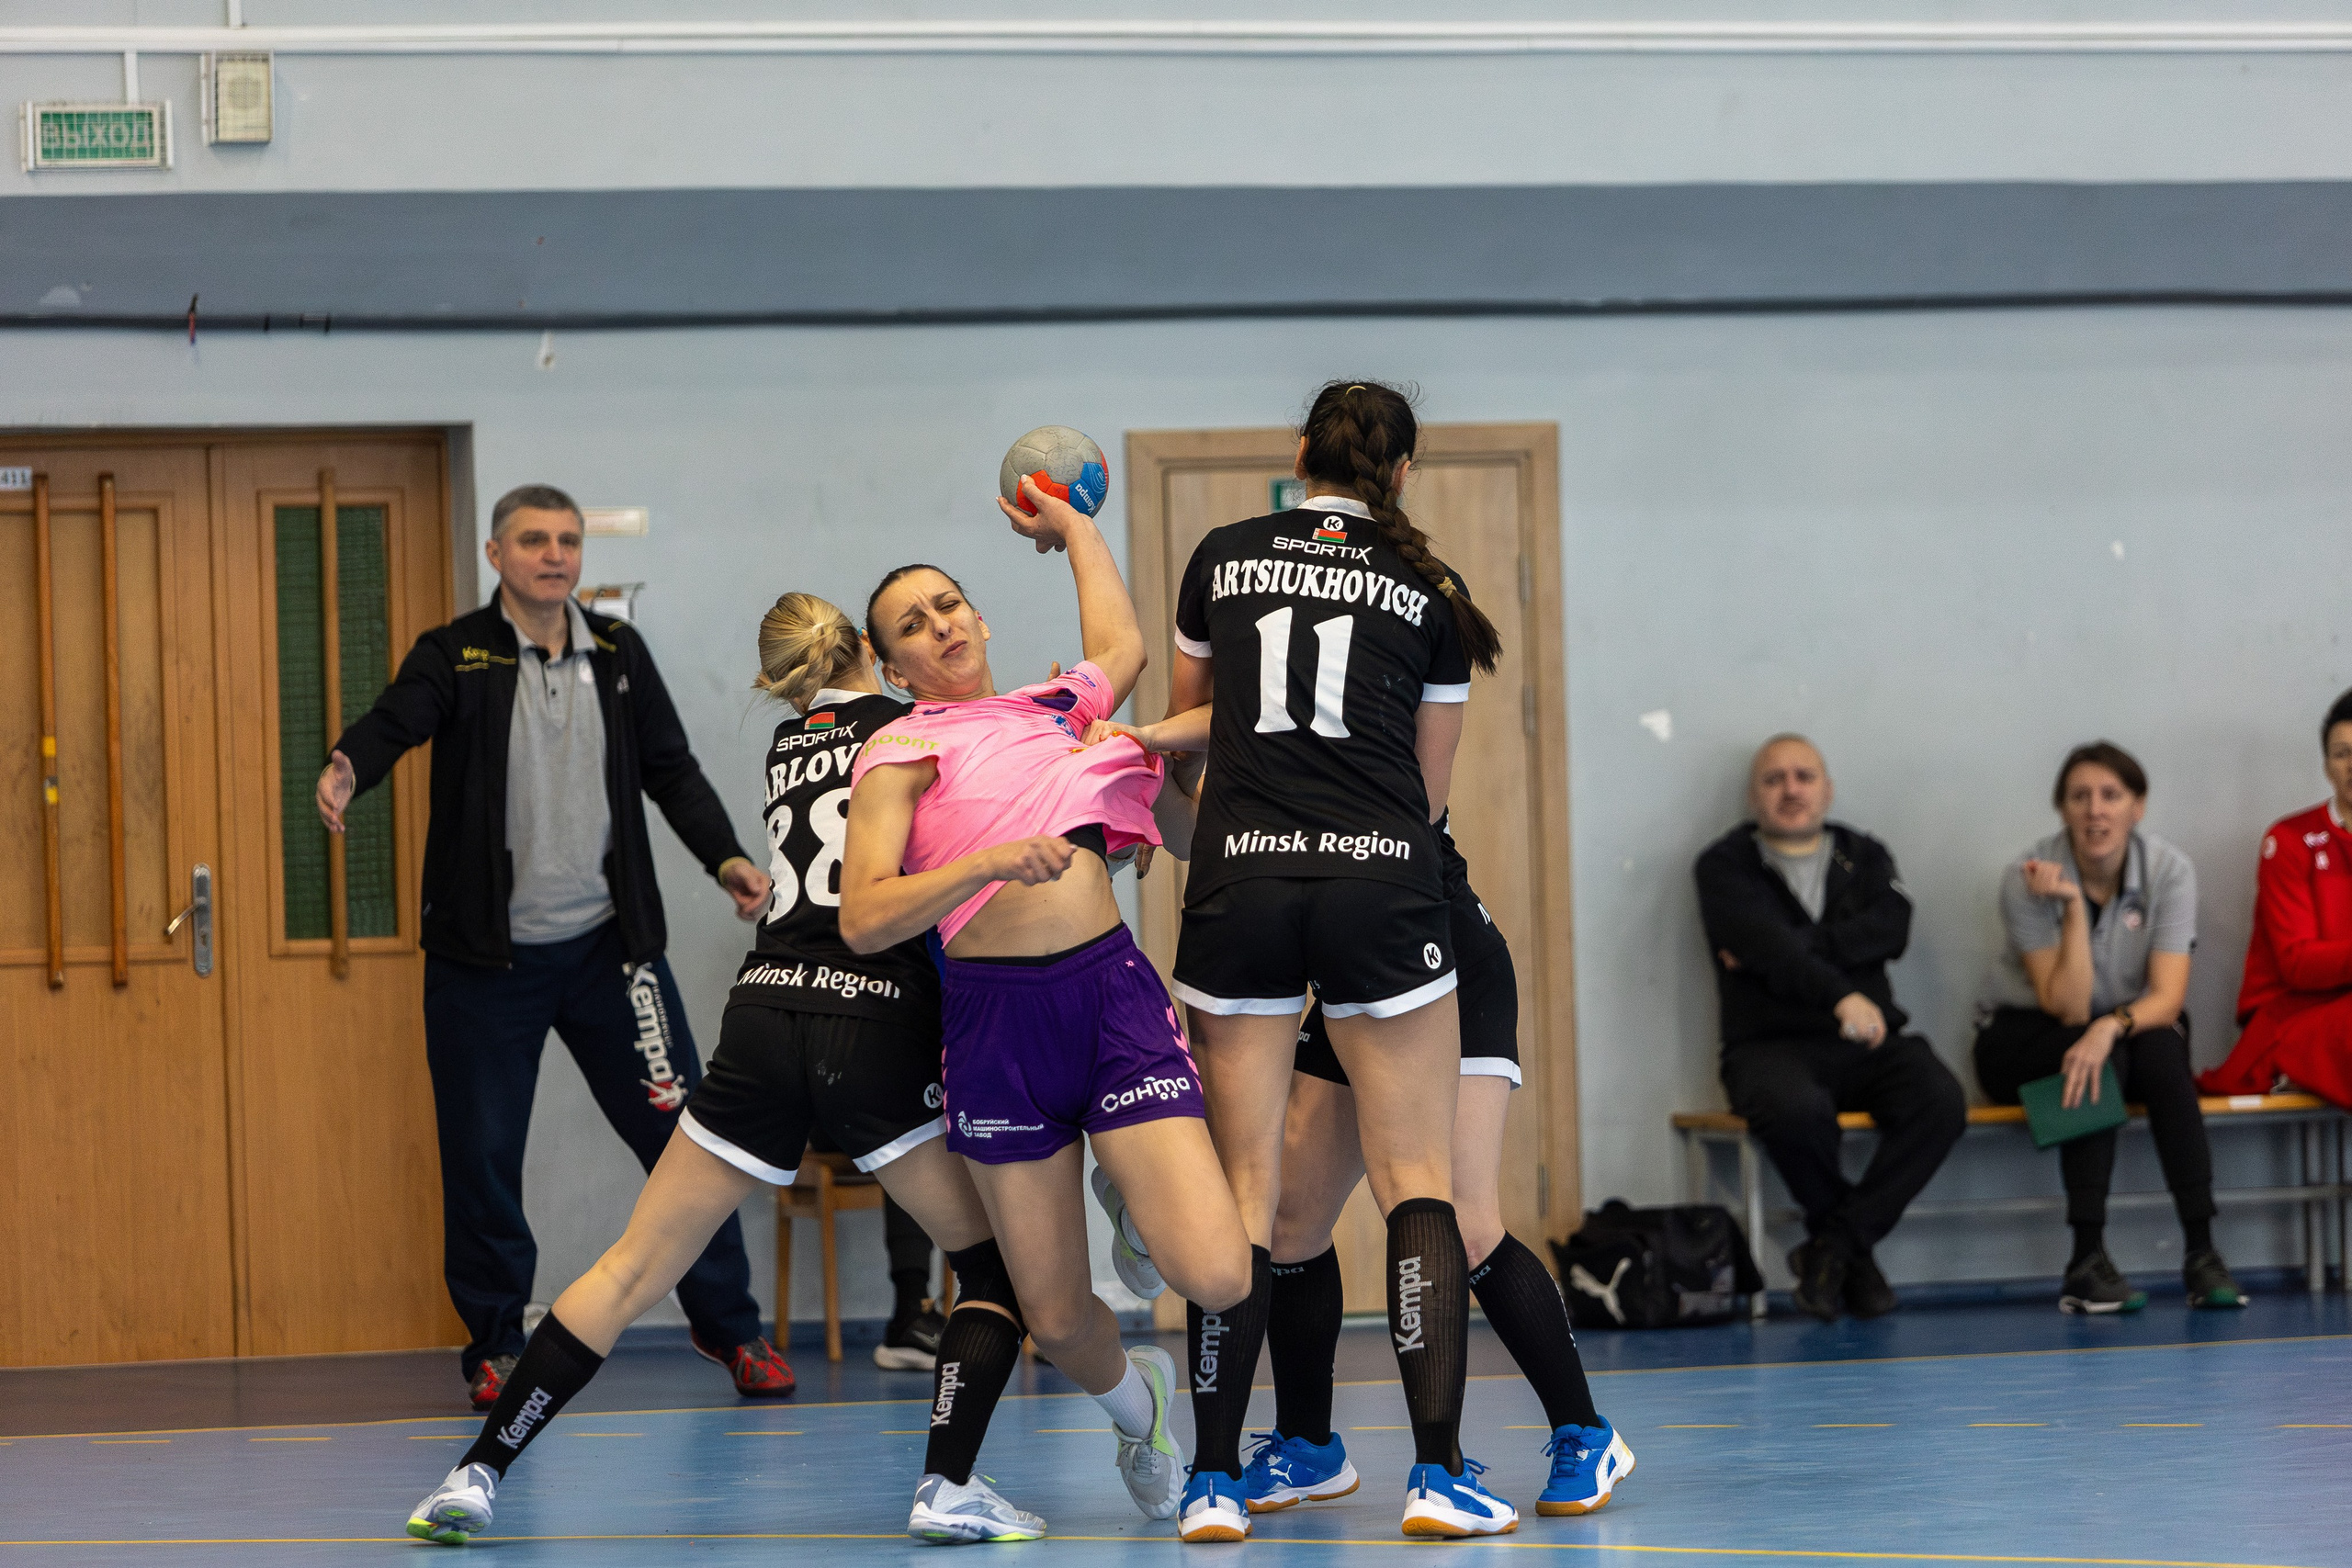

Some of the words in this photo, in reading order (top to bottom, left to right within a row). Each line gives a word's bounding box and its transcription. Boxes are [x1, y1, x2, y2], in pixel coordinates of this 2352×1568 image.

[43, 120, 150, 149] ВЫХОД
[1074, 483, 1097, 514] Kempa
[1272, 536, 1374, 566] SPORTIX
[1212, 558, 1430, 622] ARTSIUKHOVICH
[1254, 606, 1354, 739] 11
[776, 721, 858, 752] SPORTIX
[765, 742, 862, 807] ARLOV
[1224, 829, 1309, 858] Minsk
[1318, 830, 1411, 861] Region
[737, 963, 808, 986] Minsk
[811, 965, 900, 998] Region
[629, 962, 675, 1083] Kempa
[972, 1123, 1045, 1132] МАШИНОСТРОИТЕЛЬНЫЙ
[1395, 1256, 1432, 1354] Kempa
[1195, 1309, 1229, 1393] Kemp
[496, 1386, 552, 1449] Kempa
[931, 1361, 965, 1427] Kempa
